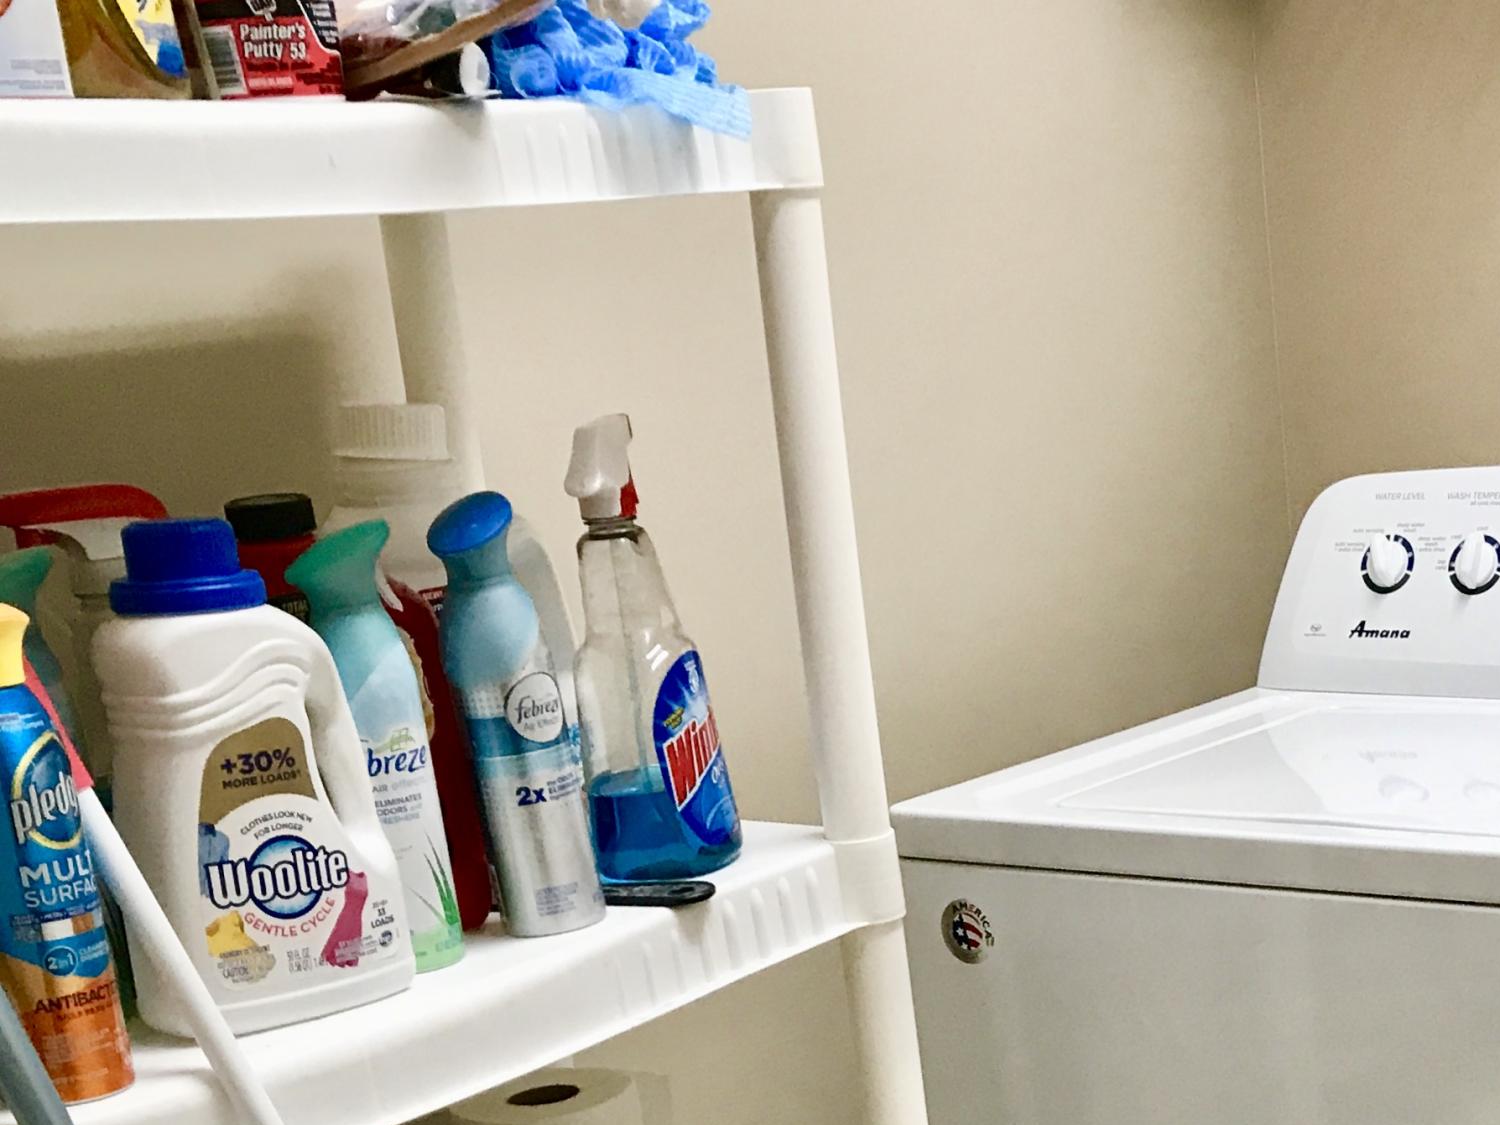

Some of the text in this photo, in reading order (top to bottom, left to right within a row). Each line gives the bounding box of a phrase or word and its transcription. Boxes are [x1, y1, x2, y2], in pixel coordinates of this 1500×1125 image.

[239, 22, 306, 41] Painter's
[243, 41, 284, 61] Putty
[1375, 493, 1426, 501] WATER LEVEL
[1447, 492, 1471, 501] WASH
[1348, 620, 1411, 640] Amana
[219, 747, 296, 776] +30%
[221, 776, 258, 791] MORE
[371, 783, 388, 794] AIR
[374, 792, 423, 809] ELIMINATES
[516, 786, 548, 807] 2x
[240, 810, 314, 836] CLOTHES LOOK NEW
[253, 822, 305, 840] FOR LONGER
[207, 845, 350, 909] Woolite
[243, 896, 337, 938] GENTLE CYCLE
[370, 916, 395, 929] LOADS
